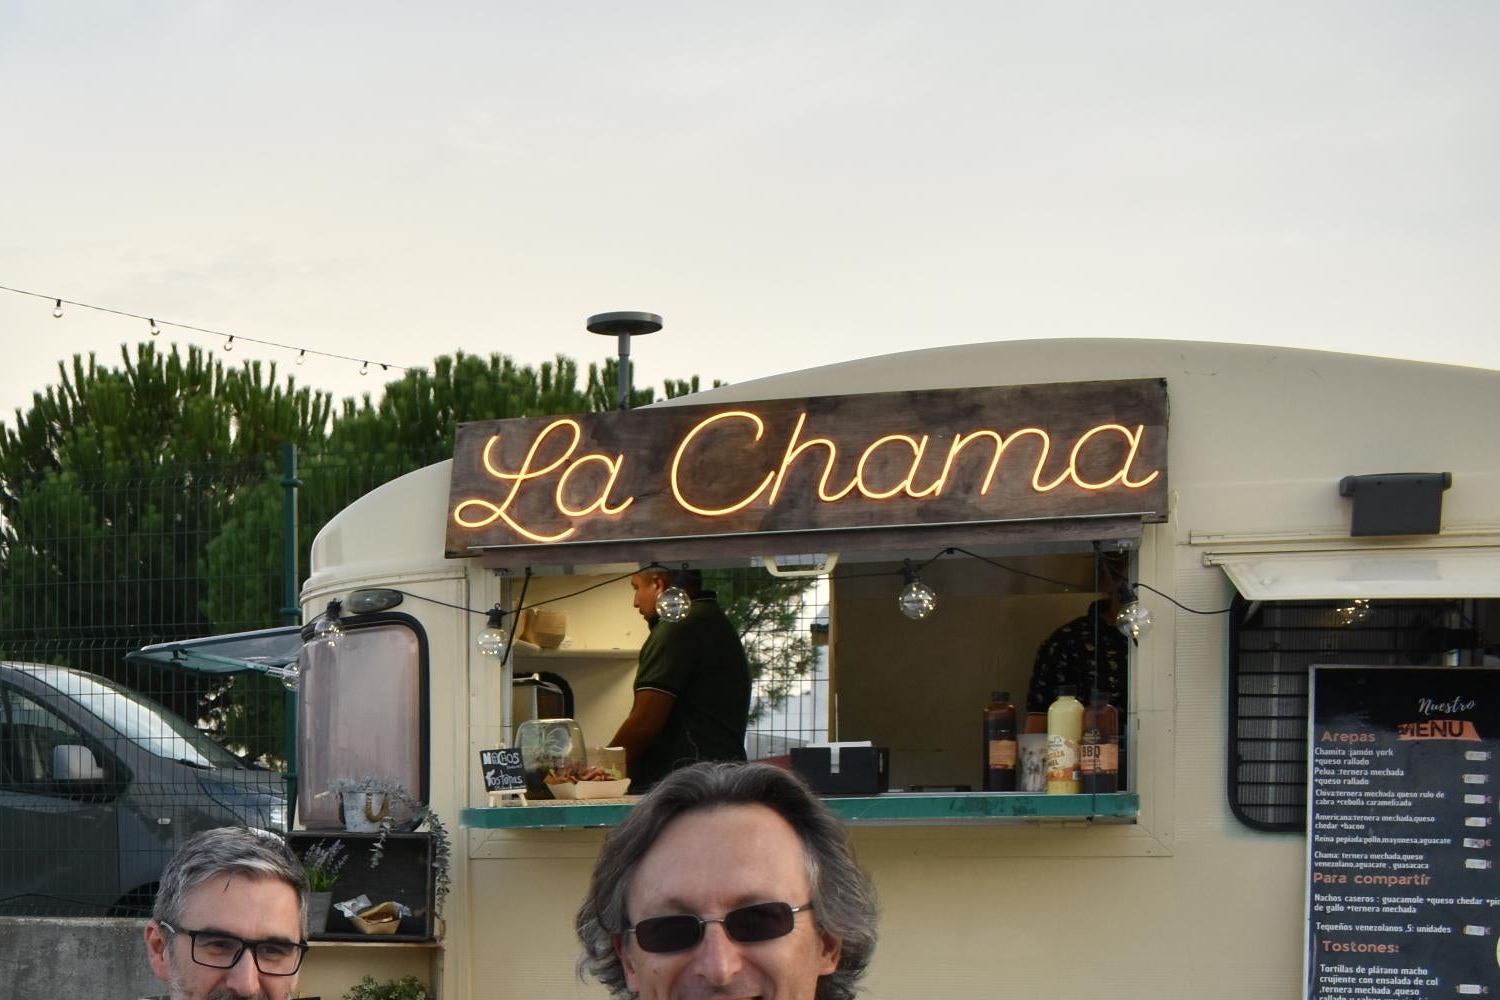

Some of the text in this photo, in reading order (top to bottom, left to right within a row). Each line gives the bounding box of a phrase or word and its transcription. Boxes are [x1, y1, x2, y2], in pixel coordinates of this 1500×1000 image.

[454, 411, 1159, 542] La Chama
[1418, 696, 1476, 715] Nuestro
[1321, 731, 1376, 744] Arepas
[1315, 747, 1346, 756] Chamita
[1375, 748, 1393, 757] york
[1343, 757, 1369, 765] rallado
[1314, 768, 1335, 776] Pelua
[1370, 768, 1404, 776] mechada
[1313, 872, 1347, 884] Para
[1314, 894, 1342, 902] Nachos
[1382, 896, 1424, 904] guacamole
[1456, 897, 1482, 905] chedar
[1314, 904, 1324, 912] de
[1326, 904, 1344, 913] gallo
[1316, 922, 1352, 931] Tequeños
[1355, 923, 1403, 932] venezolanos
[1417, 925, 1452, 933] unidades
[1322, 940, 1400, 953] Tostones:
[1320, 964, 1353, 974] Tortillas
[1356, 966, 1366, 974] de
[1401, 967, 1428, 975] macho
[1320, 975, 1356, 985] crujiente
[1376, 977, 1411, 985] ensalada
[1355, 987, 1390, 995] mechada
